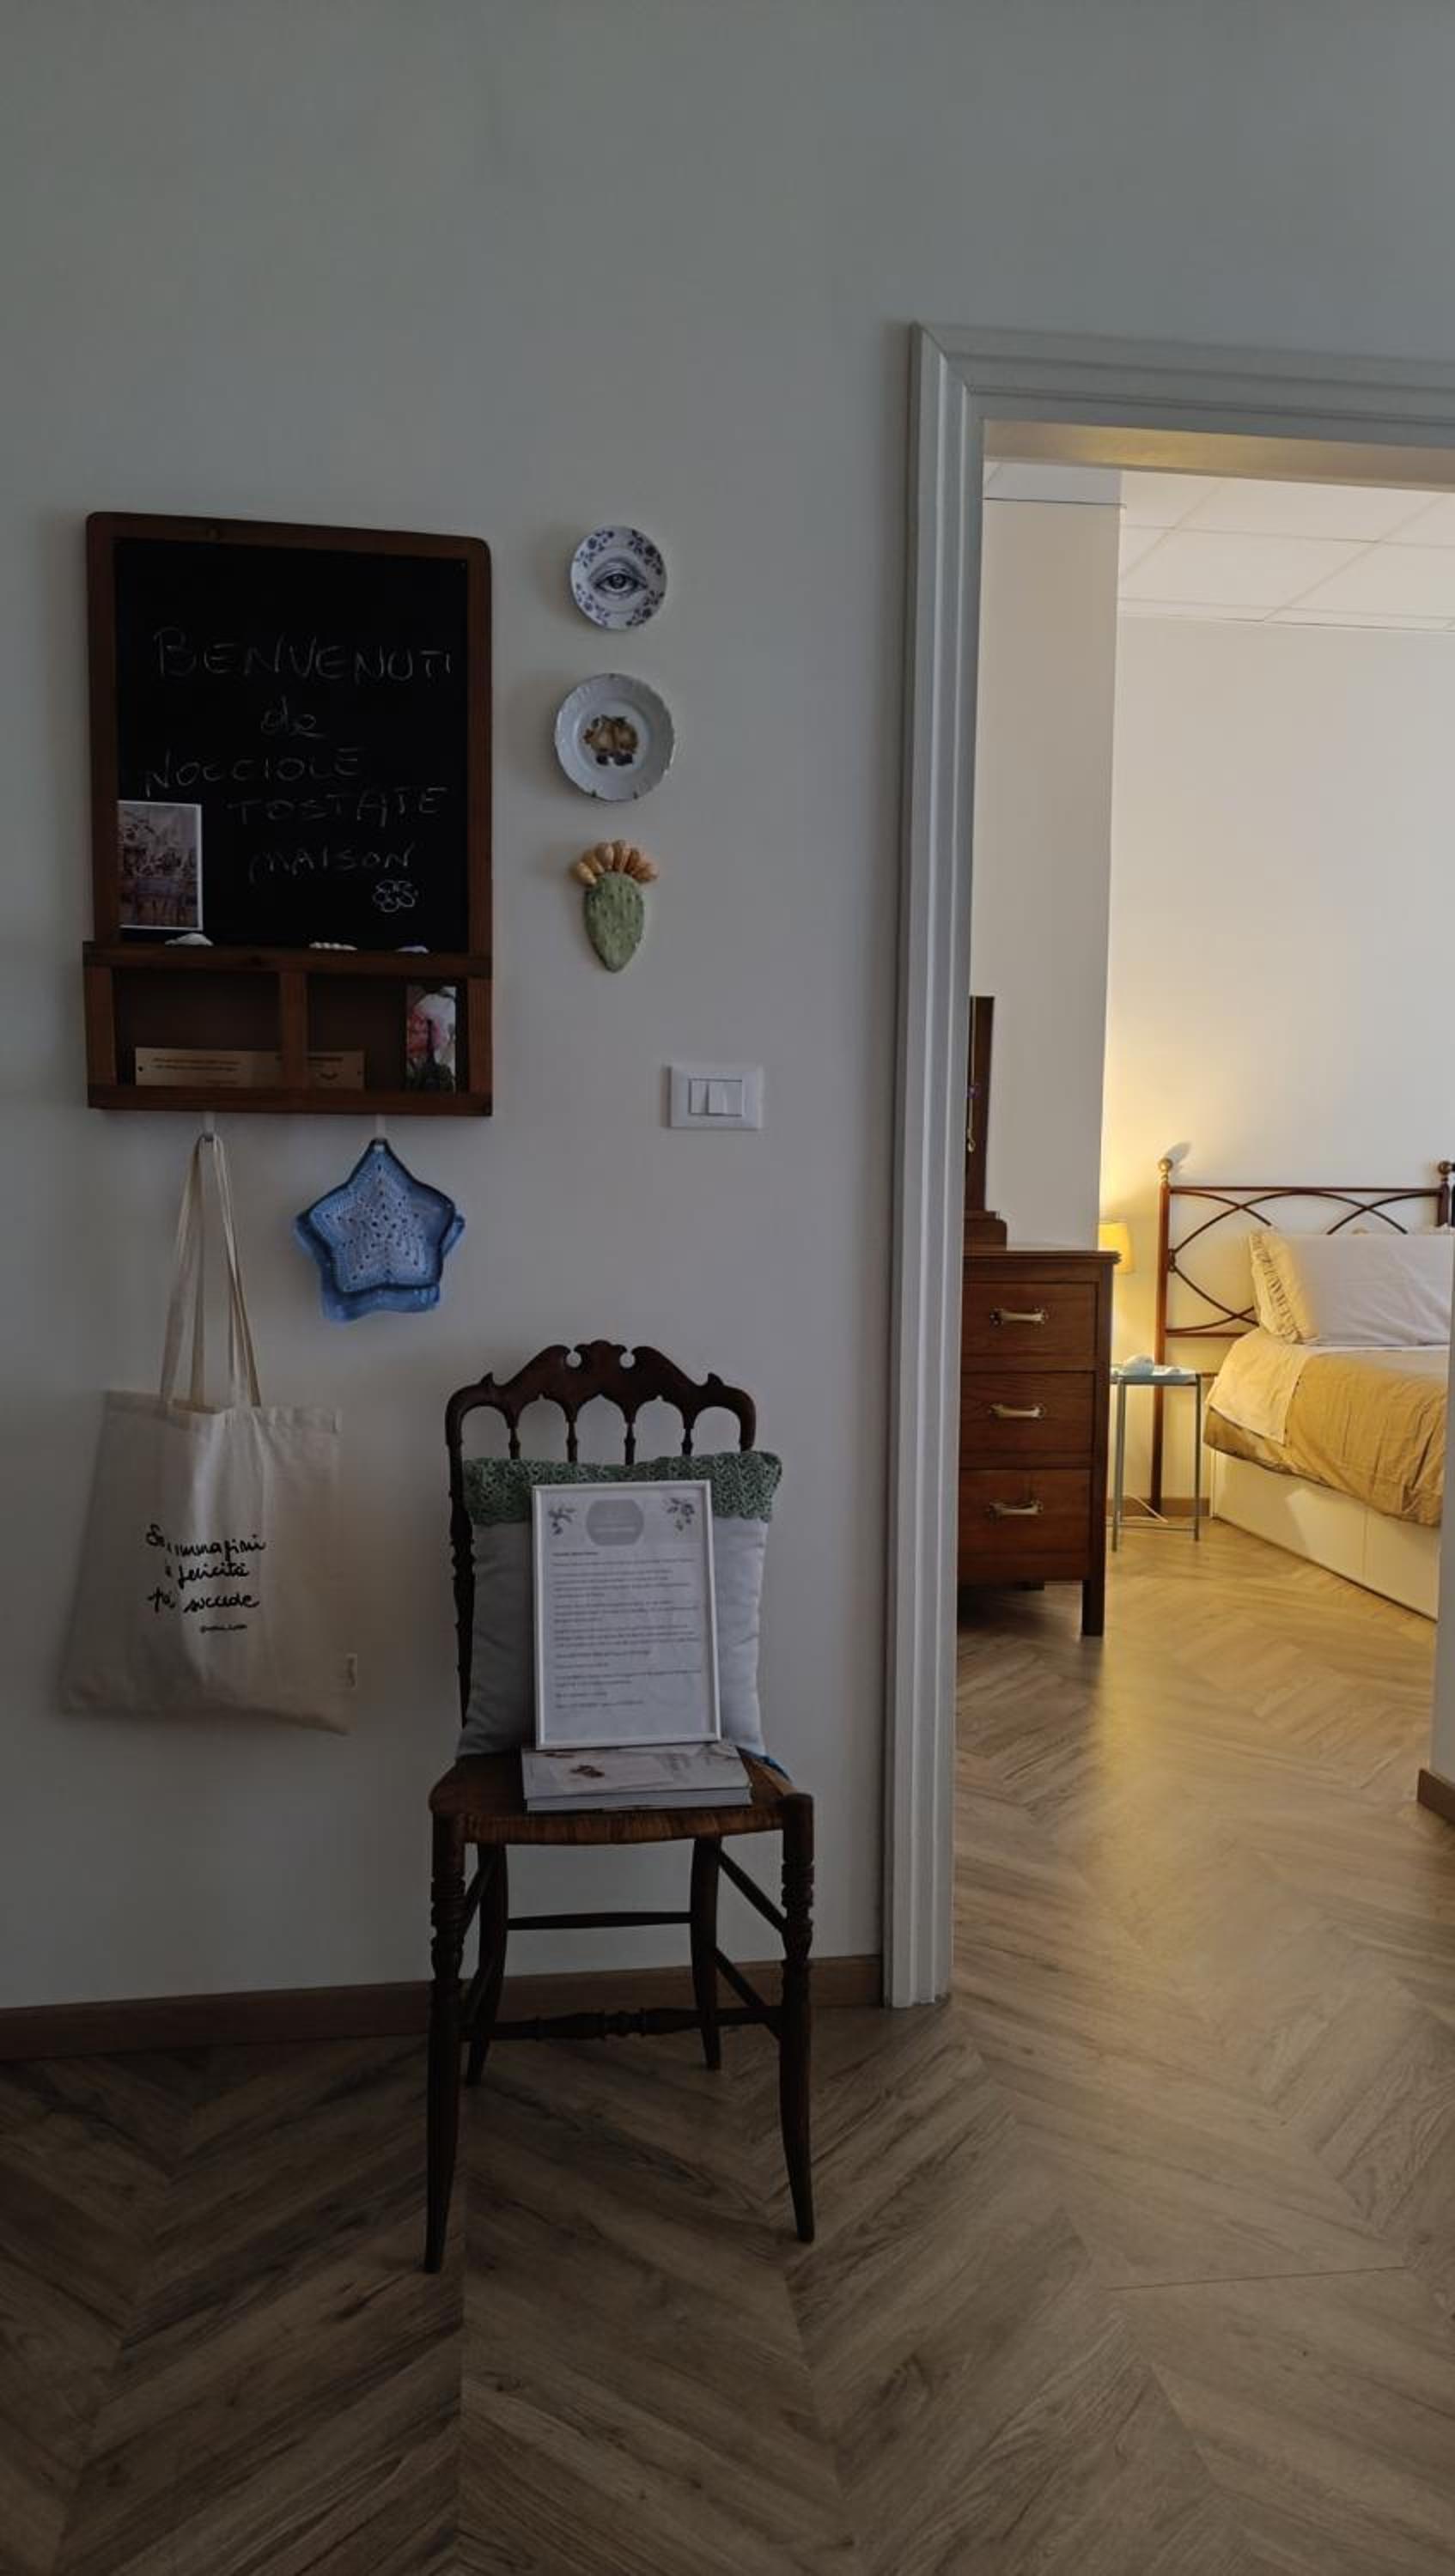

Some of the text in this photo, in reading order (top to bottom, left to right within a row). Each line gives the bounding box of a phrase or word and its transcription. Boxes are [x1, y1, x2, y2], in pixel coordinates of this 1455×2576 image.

[154, 626, 451, 683] BENVENUTI
[144, 748, 360, 798] NOCCIOLE
[226, 785, 447, 828] TOSTATE
